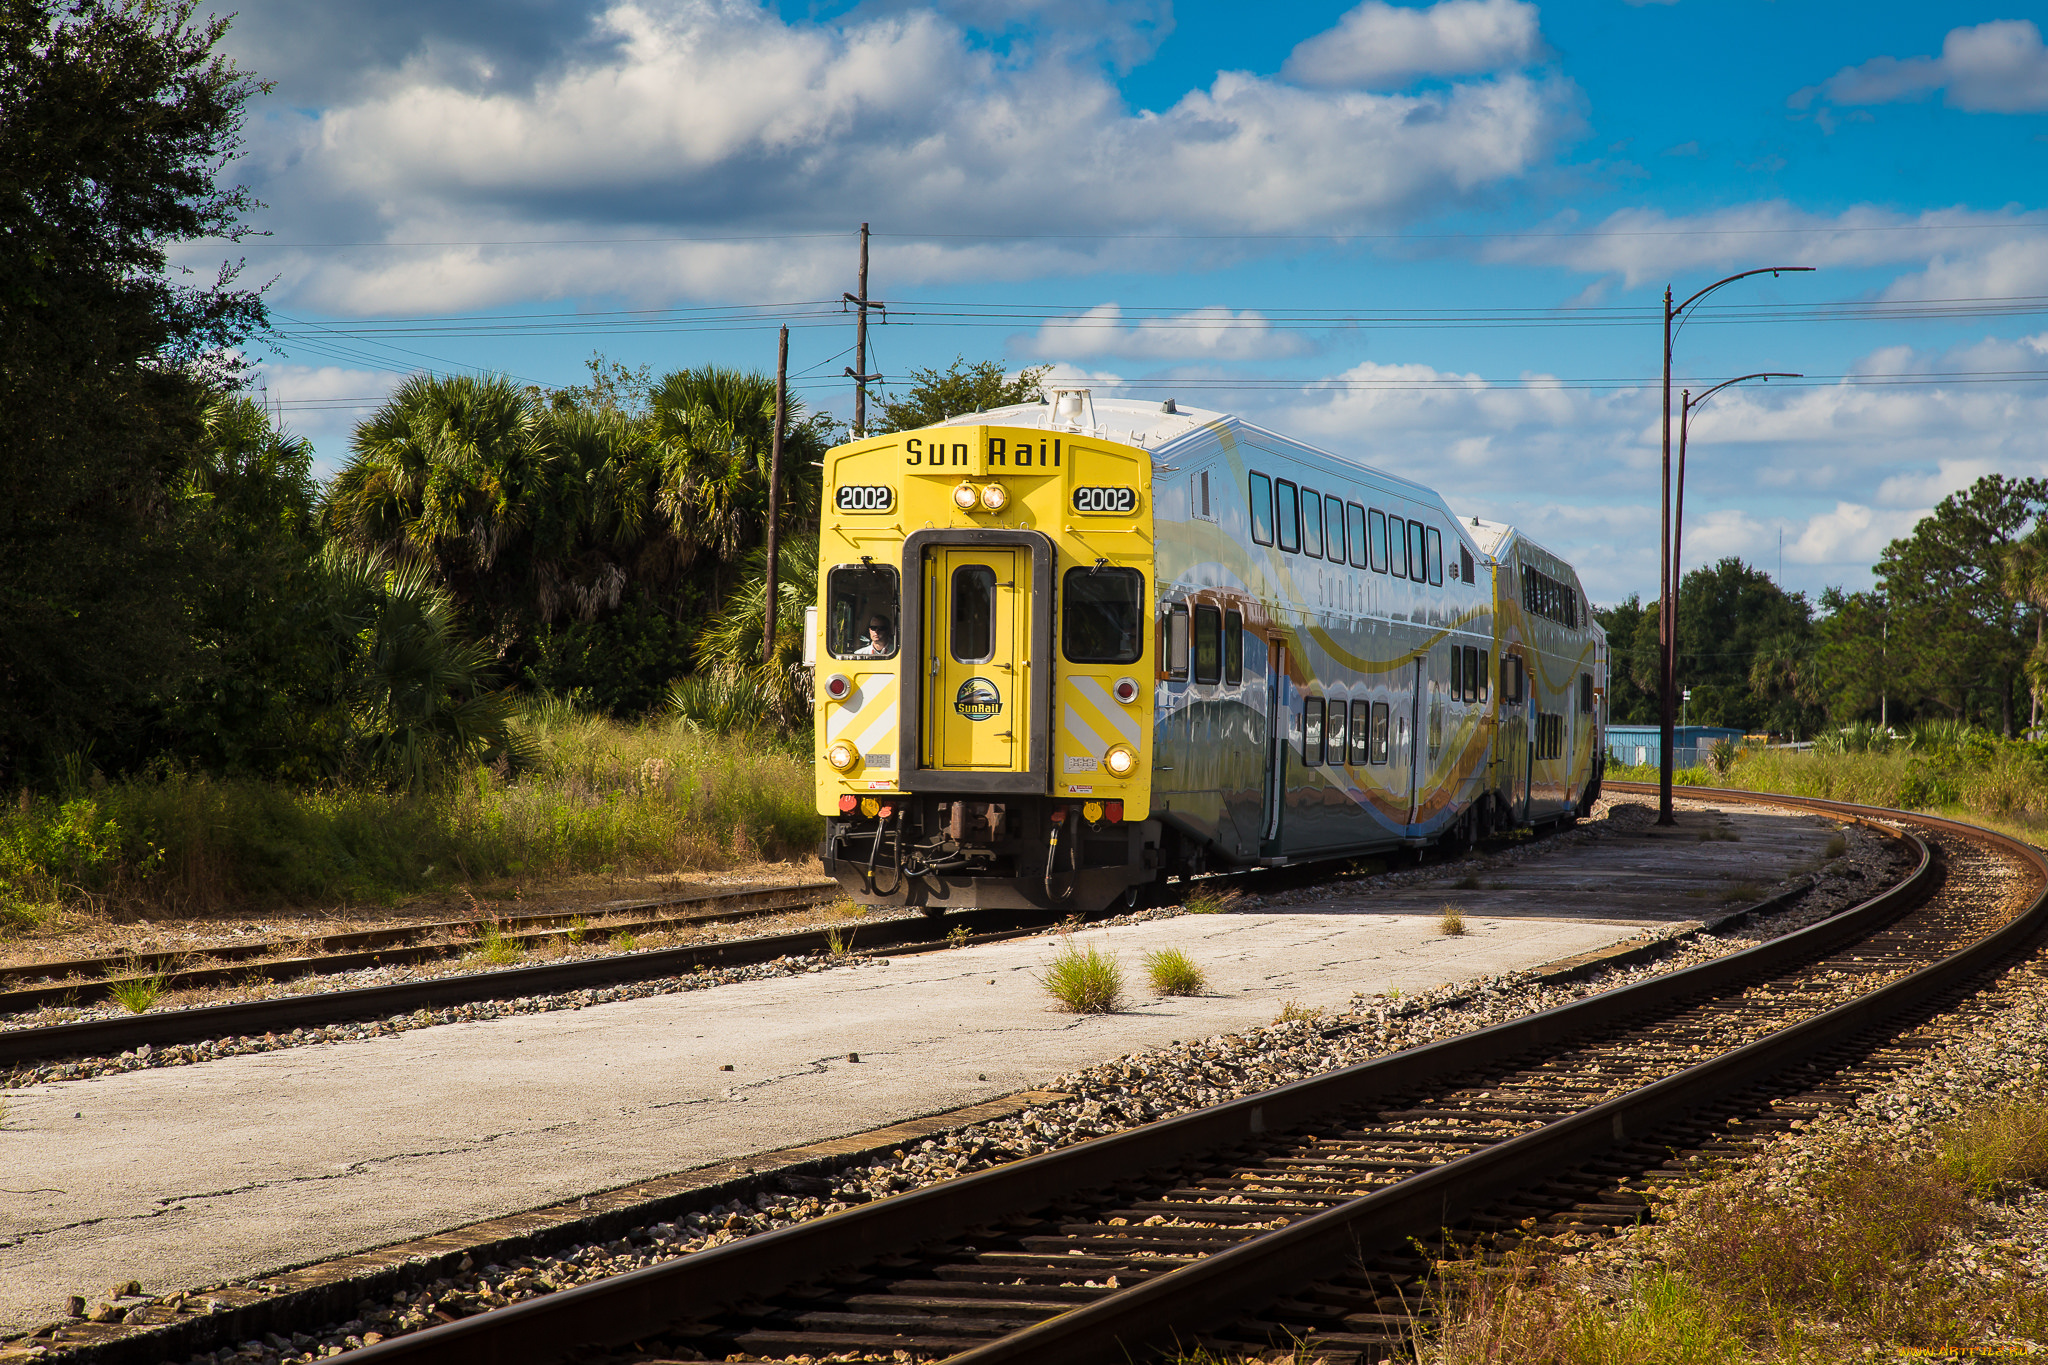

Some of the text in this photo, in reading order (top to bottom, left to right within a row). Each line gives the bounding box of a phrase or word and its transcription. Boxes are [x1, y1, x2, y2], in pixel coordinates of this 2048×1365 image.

[906, 438, 1061, 467] Sun Rail
[841, 487, 888, 509] 2002
[1078, 488, 1130, 511] 2002
[1318, 568, 1378, 616] SunRail
[958, 703, 999, 713] SunRail
